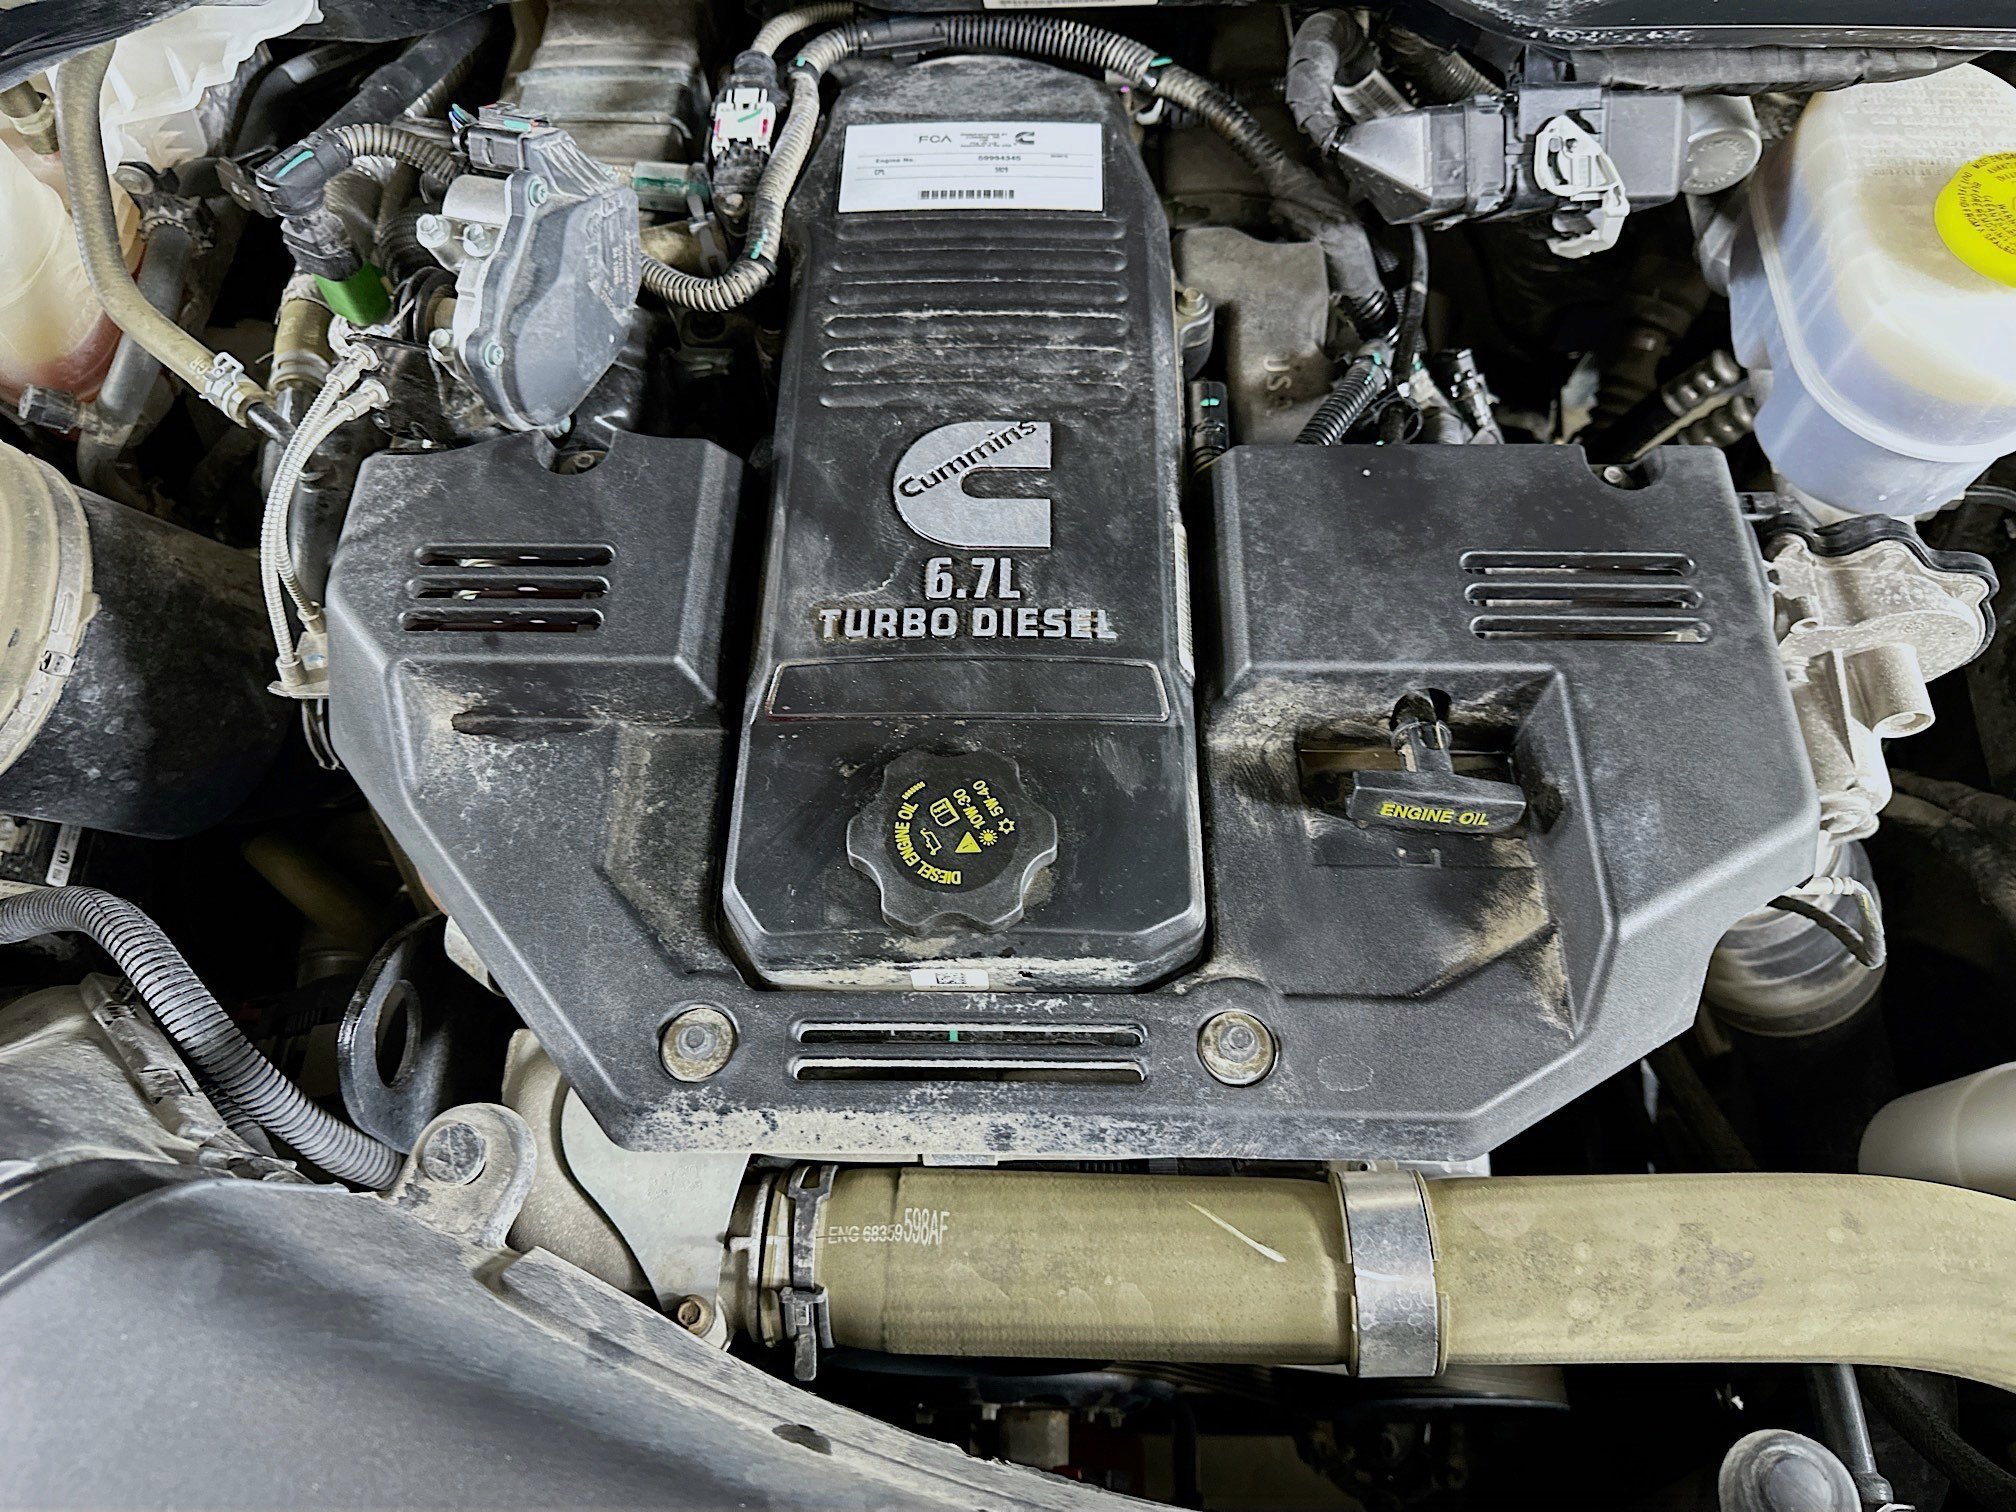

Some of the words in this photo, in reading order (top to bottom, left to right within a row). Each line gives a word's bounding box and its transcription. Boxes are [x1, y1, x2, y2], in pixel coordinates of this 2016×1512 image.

[918, 134, 952, 144] FCA
[899, 421, 1038, 497] Cummins
[925, 556, 1021, 600] 6.7L
[818, 607, 958, 640] TURBO
[971, 607, 1118, 640] DIESEL
[897, 801, 919, 820] OIL
[952, 788, 986, 830] 10W-30
[972, 780, 1004, 817] 5W-40
[1380, 802, 1455, 825] ENGINE
[1459, 811, 1490, 826] OIL
[894, 821, 921, 867] ENGINE
[917, 860, 962, 885] DIESEL
[828, 1225, 860, 1244] ENG
